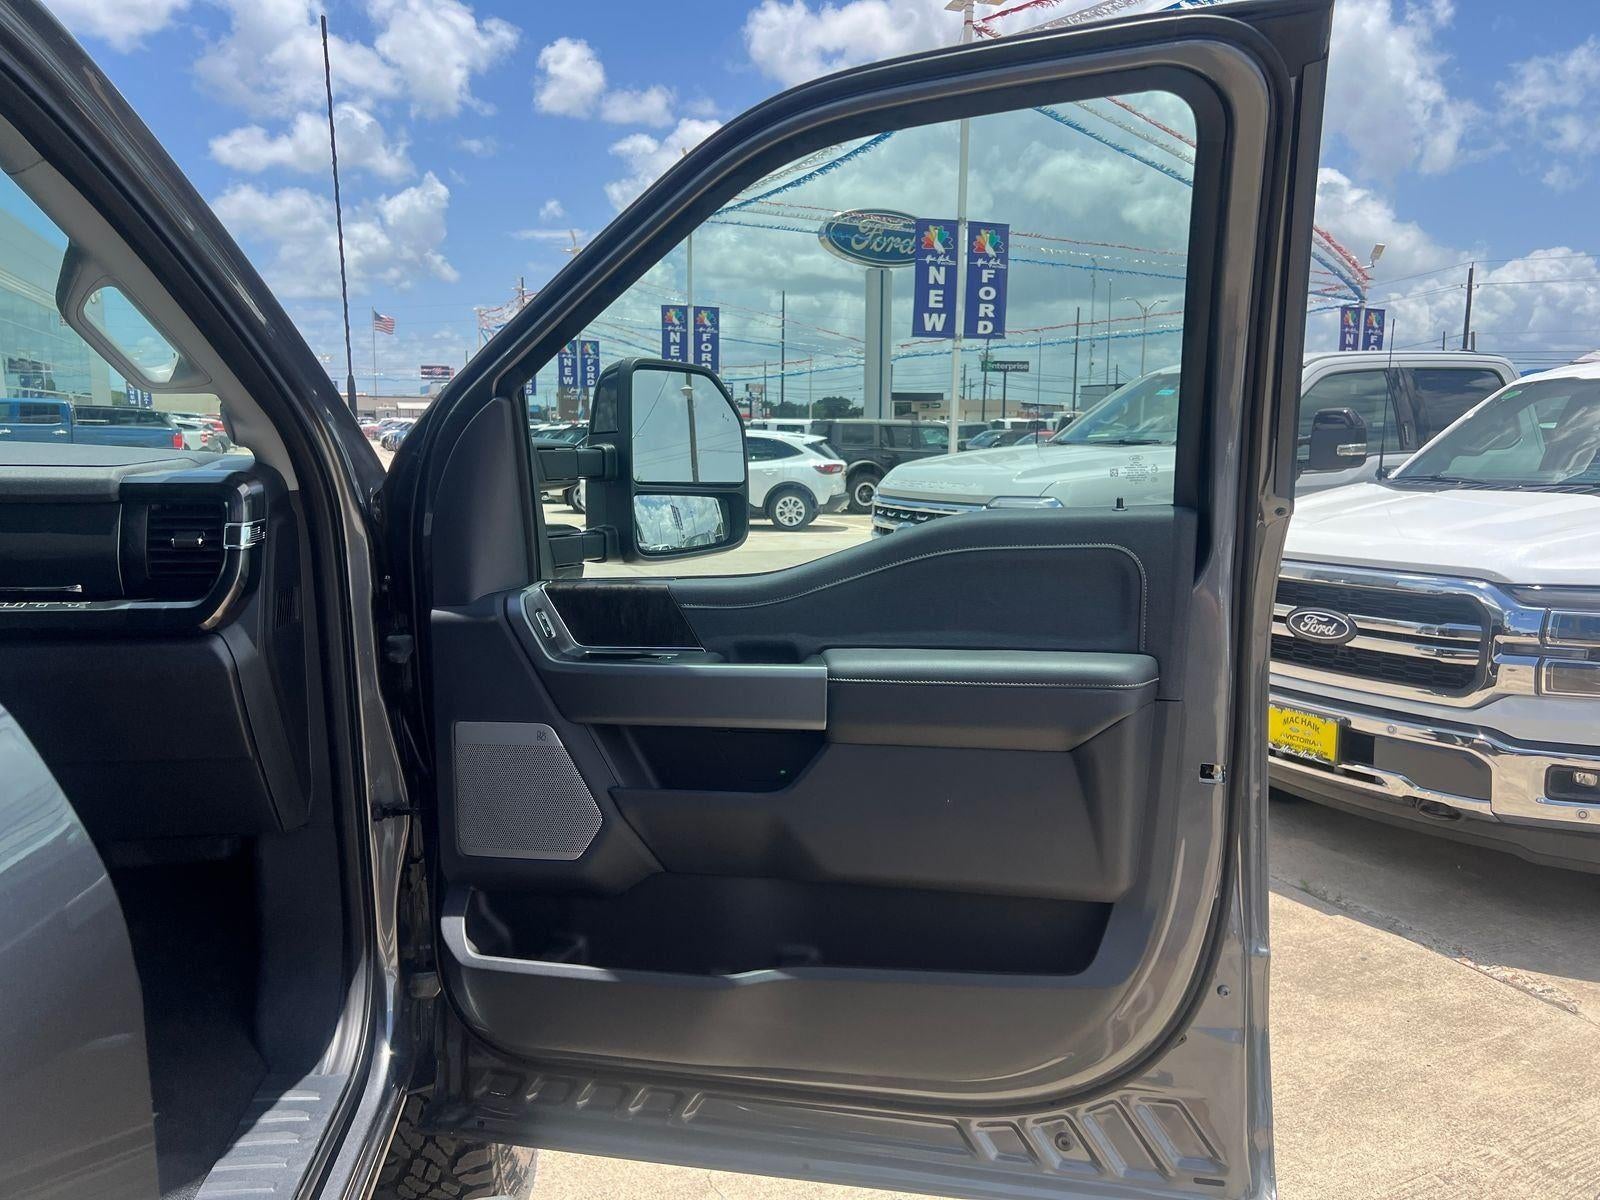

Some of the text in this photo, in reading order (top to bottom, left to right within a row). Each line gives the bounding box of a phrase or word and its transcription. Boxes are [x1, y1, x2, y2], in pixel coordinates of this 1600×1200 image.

[851, 219, 915, 255] Ford
[923, 266, 947, 332] NEW
[977, 269, 997, 335] FORD
[670, 332, 682, 362] NE
[1368, 335, 1378, 351] FO
[562, 358, 574, 385] NEW
[586, 359, 595, 386] FORD
[1299, 614, 1338, 636] Ford
[1283, 716, 1320, 734] MAC HAIK
[1285, 734, 1316, 747] VICTORIA
